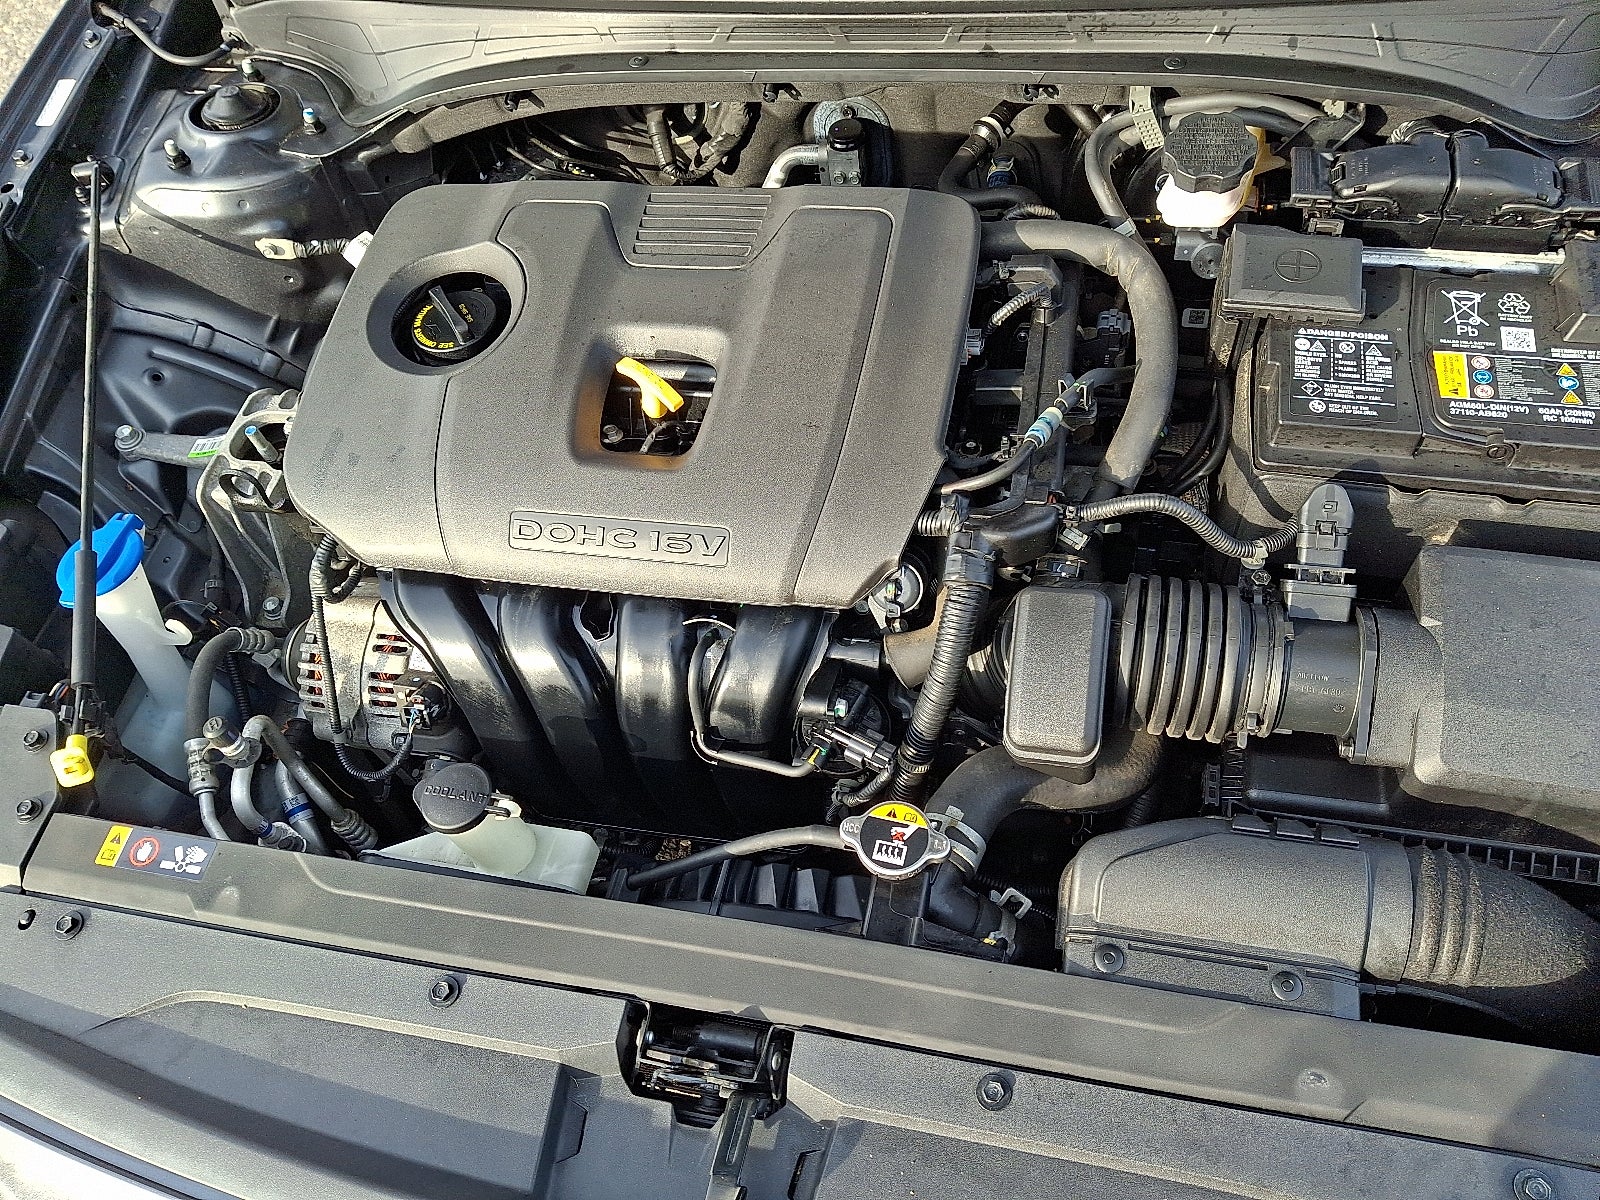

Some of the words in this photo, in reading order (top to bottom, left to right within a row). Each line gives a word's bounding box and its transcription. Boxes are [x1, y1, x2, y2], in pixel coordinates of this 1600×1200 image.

[414, 304, 433, 328] MANUAL
[414, 328, 437, 348] OWNER'S
[1456, 324, 1479, 337] Pb
[1542, 414, 1558, 422] RC
[512, 518, 637, 549] DOHC
[649, 530, 727, 557] 16V
[424, 784, 489, 804] COOLANT
